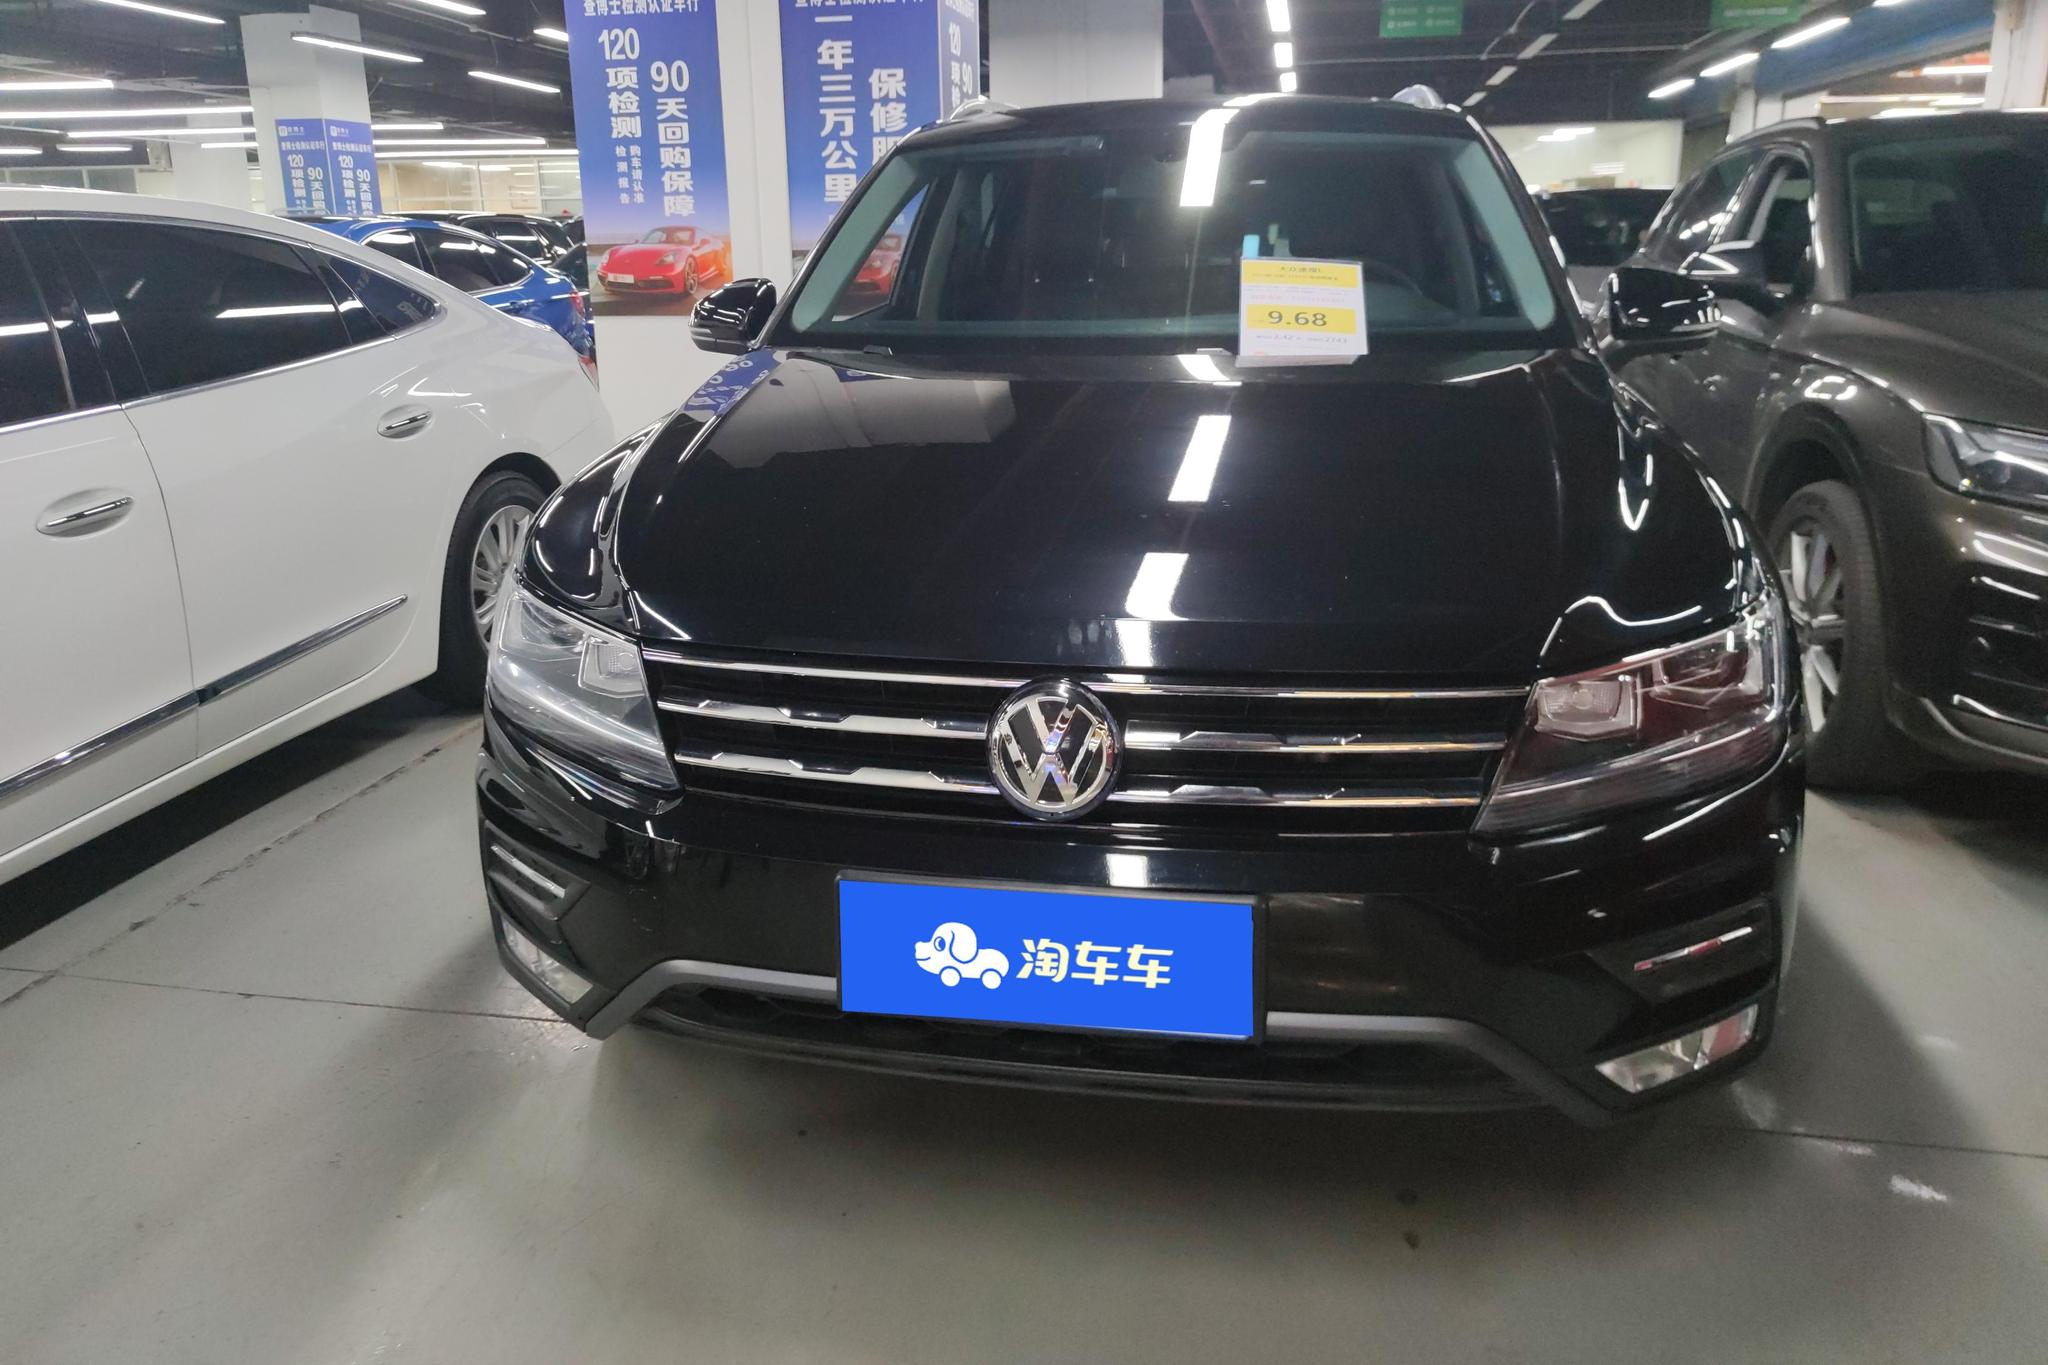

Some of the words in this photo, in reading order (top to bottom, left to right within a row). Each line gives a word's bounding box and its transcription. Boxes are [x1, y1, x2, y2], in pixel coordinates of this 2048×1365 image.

[598, 27, 642, 138] 120项检测
[650, 60, 695, 217] 90天回购保障
[815, 15, 858, 202] 一年三万公里
[1267, 310, 1328, 327] 9.68
